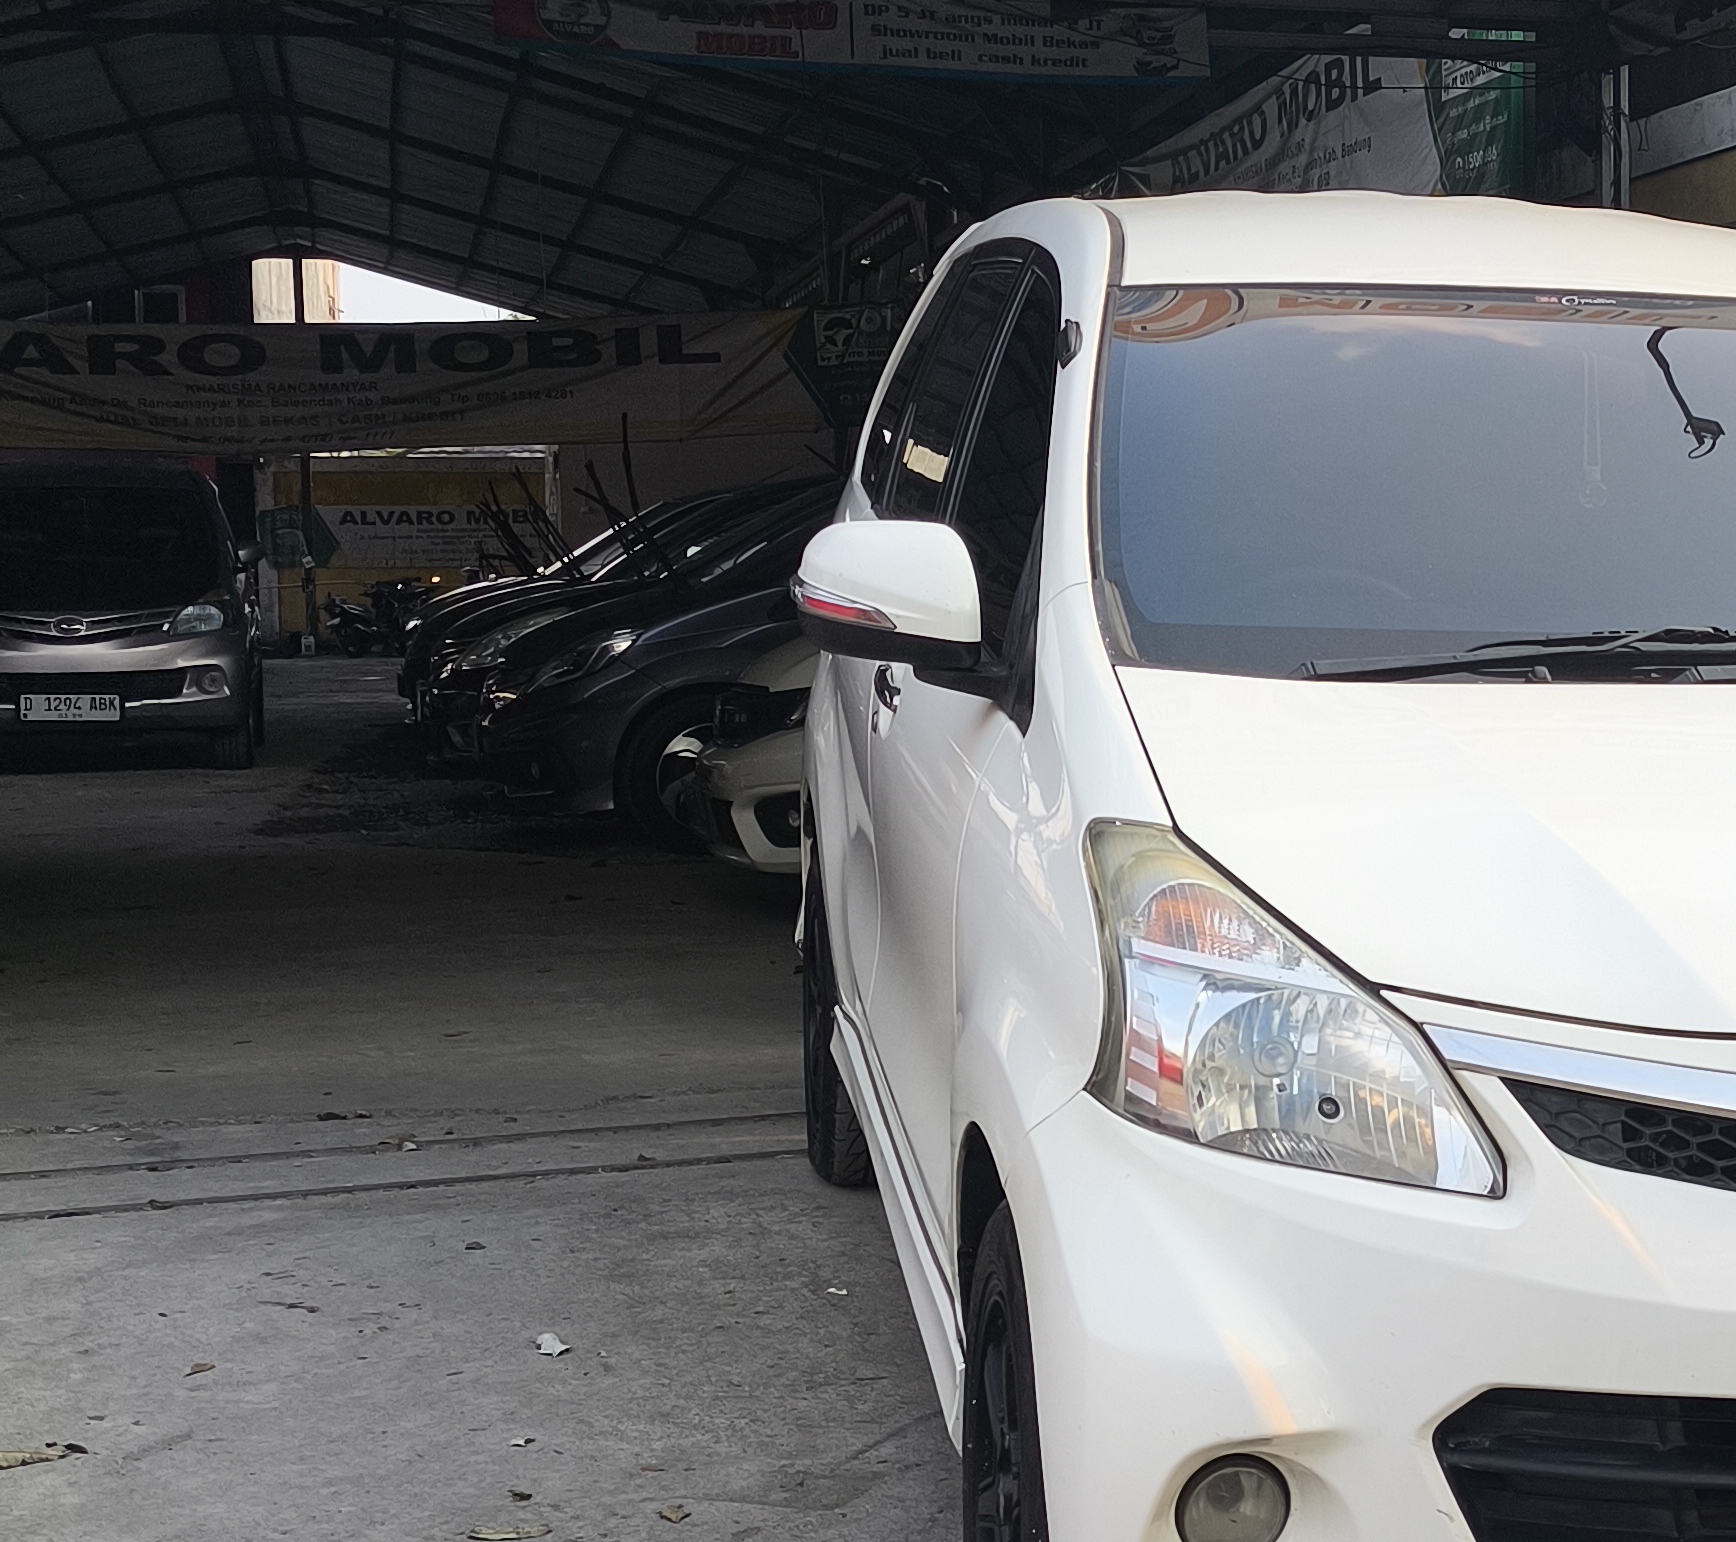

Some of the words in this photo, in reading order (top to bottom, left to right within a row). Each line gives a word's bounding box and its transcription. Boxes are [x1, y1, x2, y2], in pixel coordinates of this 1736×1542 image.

[695, 31, 800, 59] MOBIL
[870, 23, 976, 45] Showroom
[982, 31, 1035, 48] Mobil
[1042, 35, 1100, 50] Bekas
[880, 44, 919, 60] jual
[1030, 53, 1090, 70] kredit
[1169, 104, 1268, 188] ALVARO
[1274, 55, 1383, 139] MOBIL
[0, 331, 266, 376] ARO
[319, 324, 721, 375] MOBIL
[185, 381, 264, 395] KHARISMA
[268, 381, 379, 394] RANCAMANYAR
[338, 510, 455, 526] ALVARO
[23, 697, 33, 711] D
[44, 697, 82, 711] 1294
[89, 697, 118, 711] ABK
